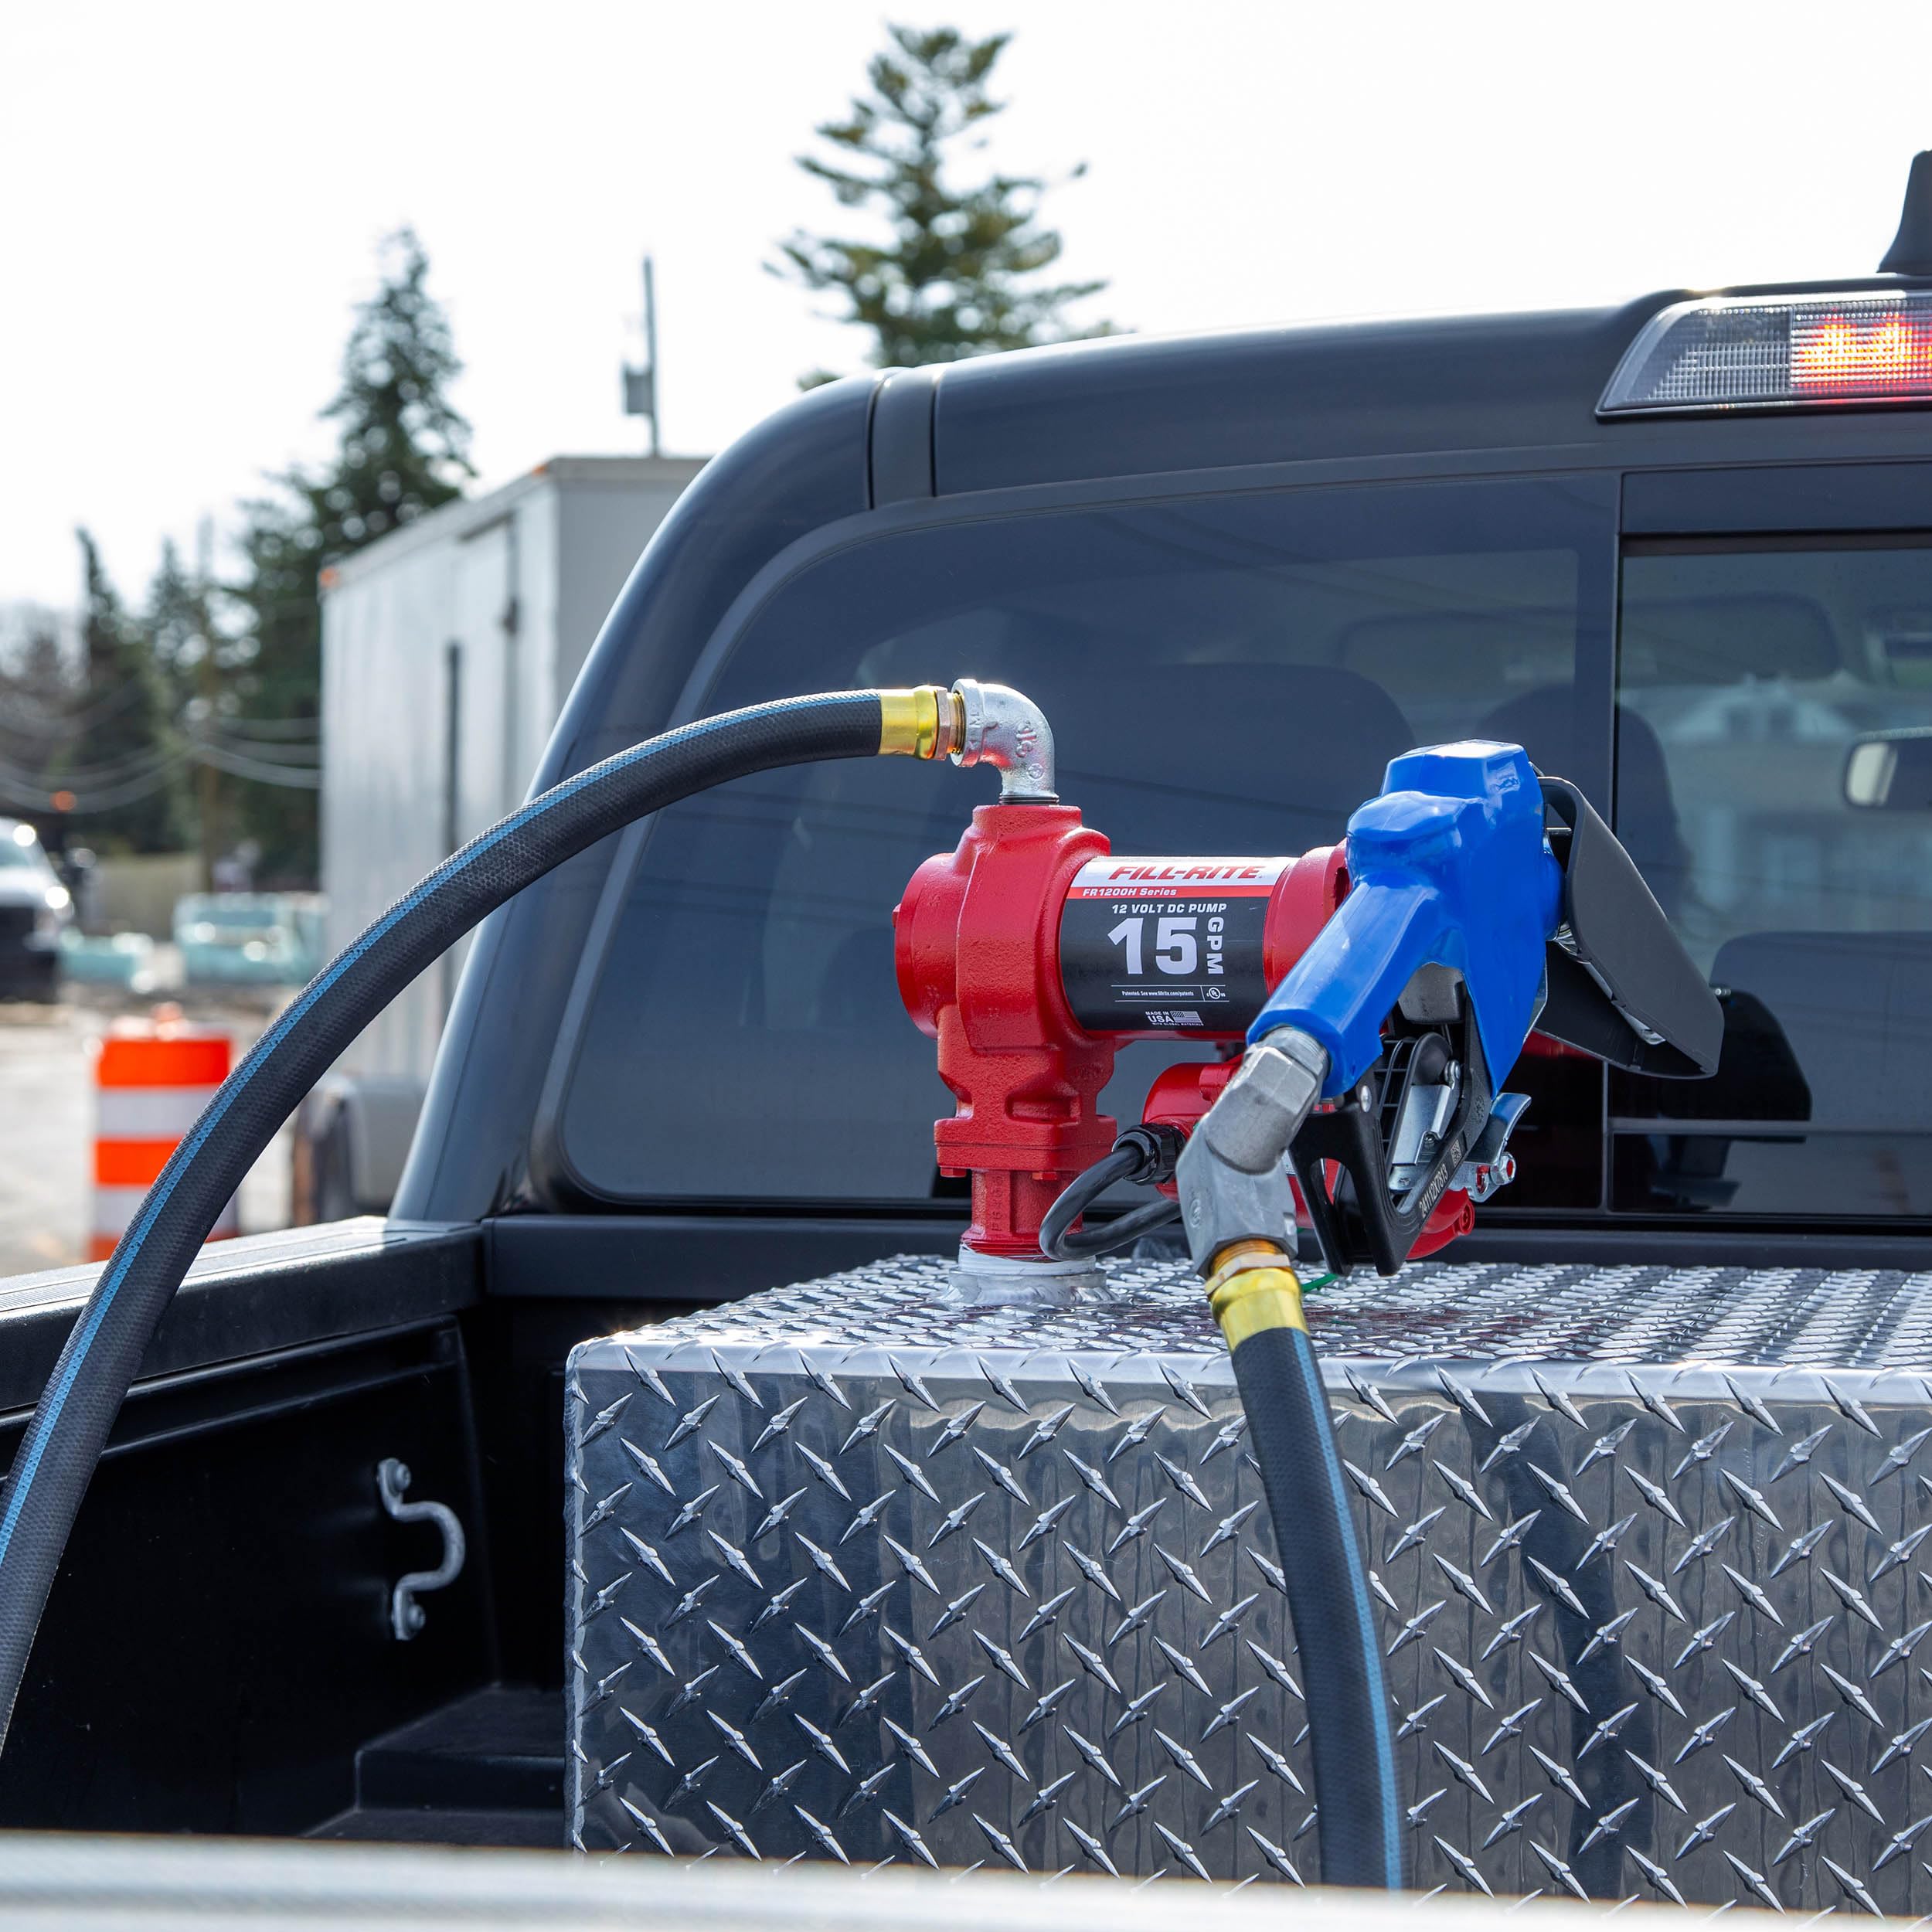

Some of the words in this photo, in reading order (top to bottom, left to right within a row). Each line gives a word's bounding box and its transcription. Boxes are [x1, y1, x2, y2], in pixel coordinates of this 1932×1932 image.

[1108, 866, 1266, 880] FILL-RITE
[1083, 888, 1136, 896] FR1200H
[1139, 887, 1177, 896] Series
[1112, 904, 1128, 914] 12
[1131, 904, 1164, 913] VOLT
[1167, 903, 1185, 913] DC
[1188, 903, 1227, 913] PUMP
[1107, 917, 1197, 975] 15
[1207, 917, 1224, 975] GPM
